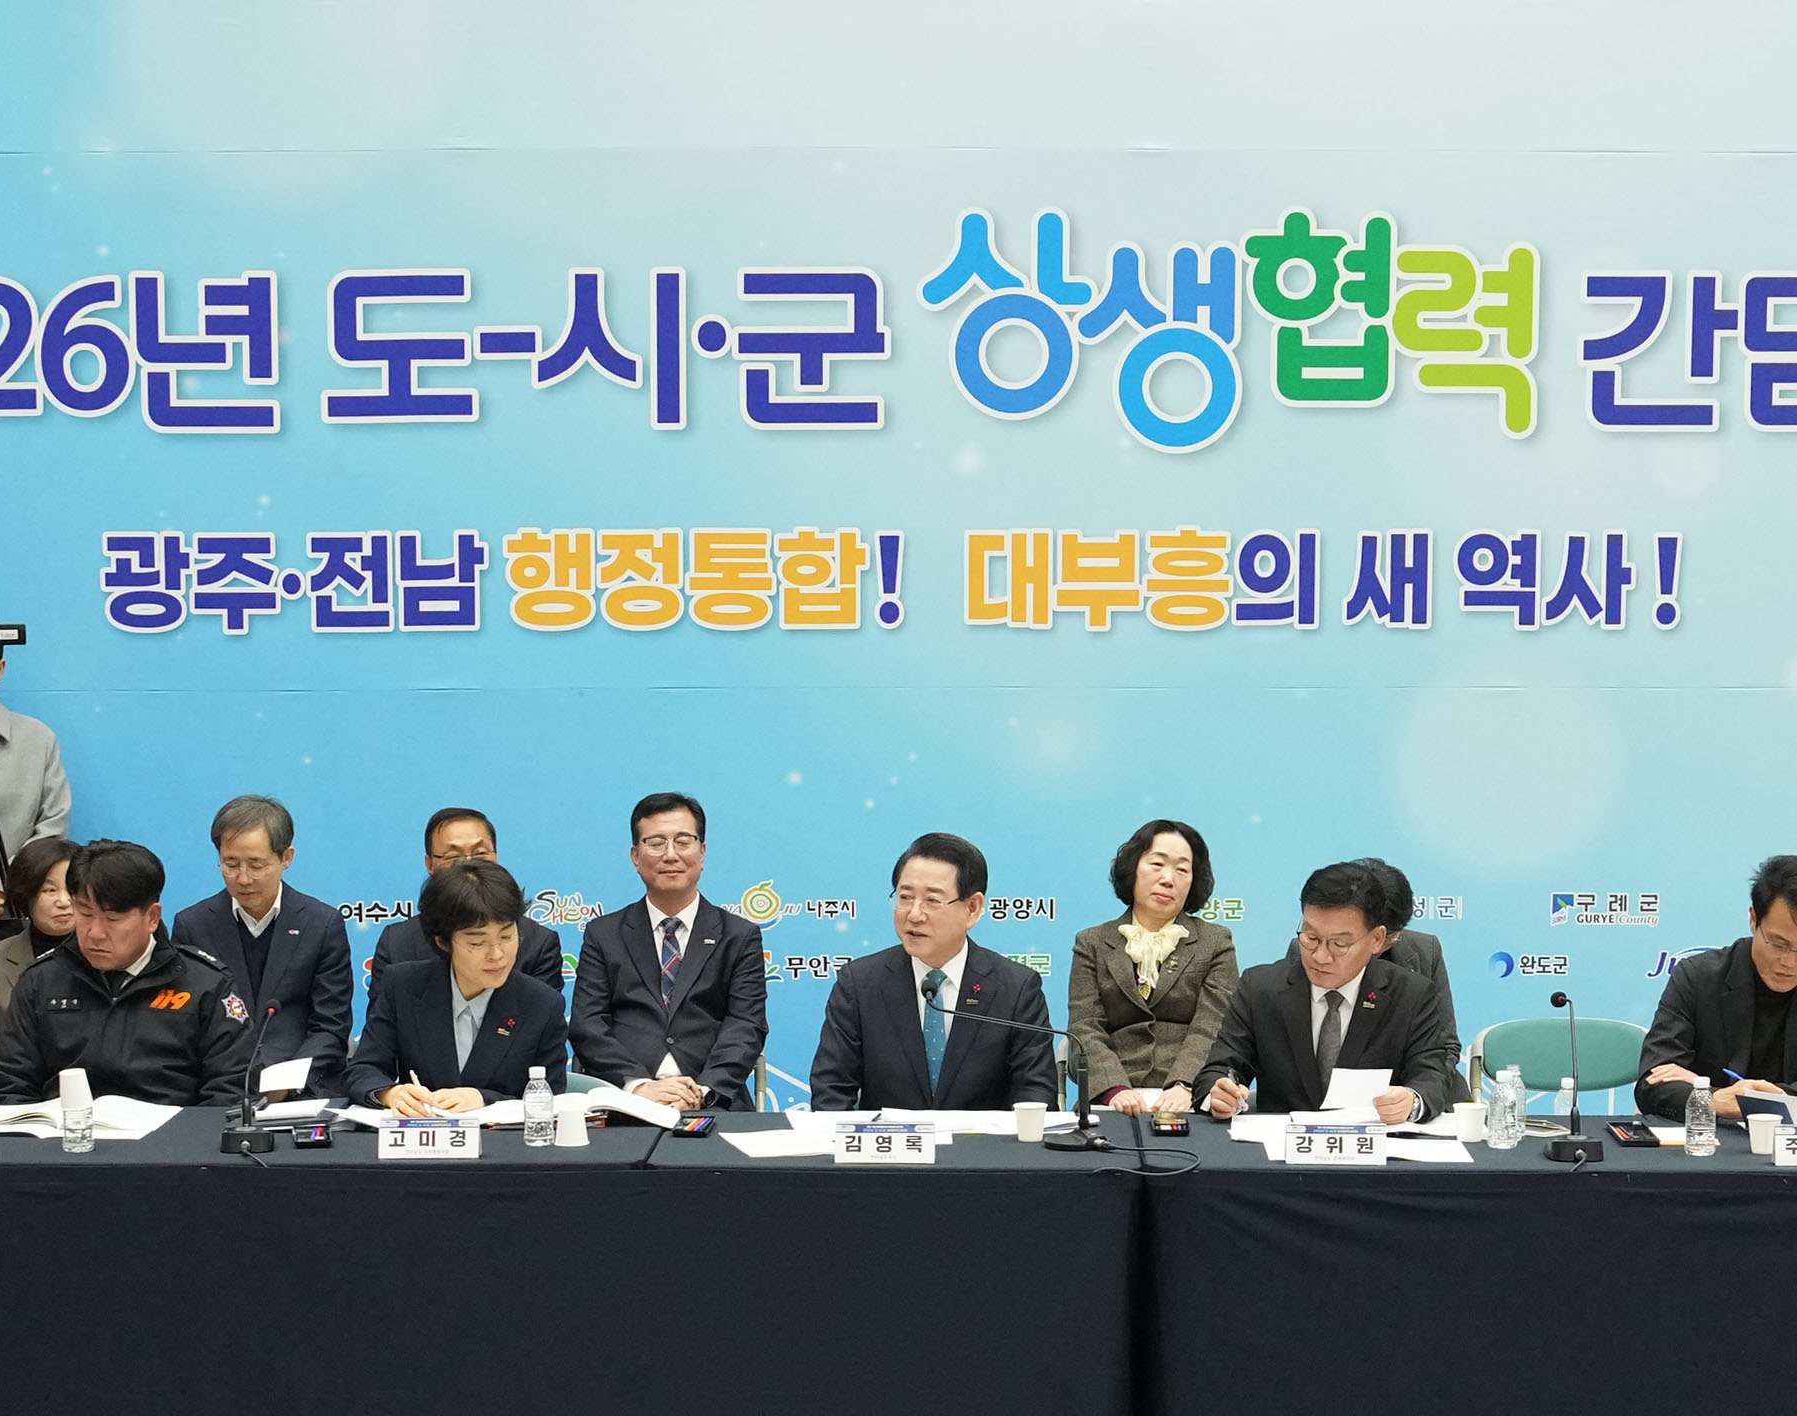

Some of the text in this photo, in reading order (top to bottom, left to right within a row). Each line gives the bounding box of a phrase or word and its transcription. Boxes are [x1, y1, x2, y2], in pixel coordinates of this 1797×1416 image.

[917, 209, 1539, 450] 상생협력
[103, 531, 487, 632] 광주·전남
[504, 529, 903, 629] 행정통합!
[966, 530, 1317, 629] 대부흥의
[1345, 532, 1432, 629] 새
[340, 900, 414, 924] 여수시
[806, 900, 856, 918] 나주시
[989, 898, 1055, 920] 광양시
[1576, 913, 1615, 924] GURYE
[1618, 914, 1659, 926] County
[1519, 955, 1568, 975] 완도군
